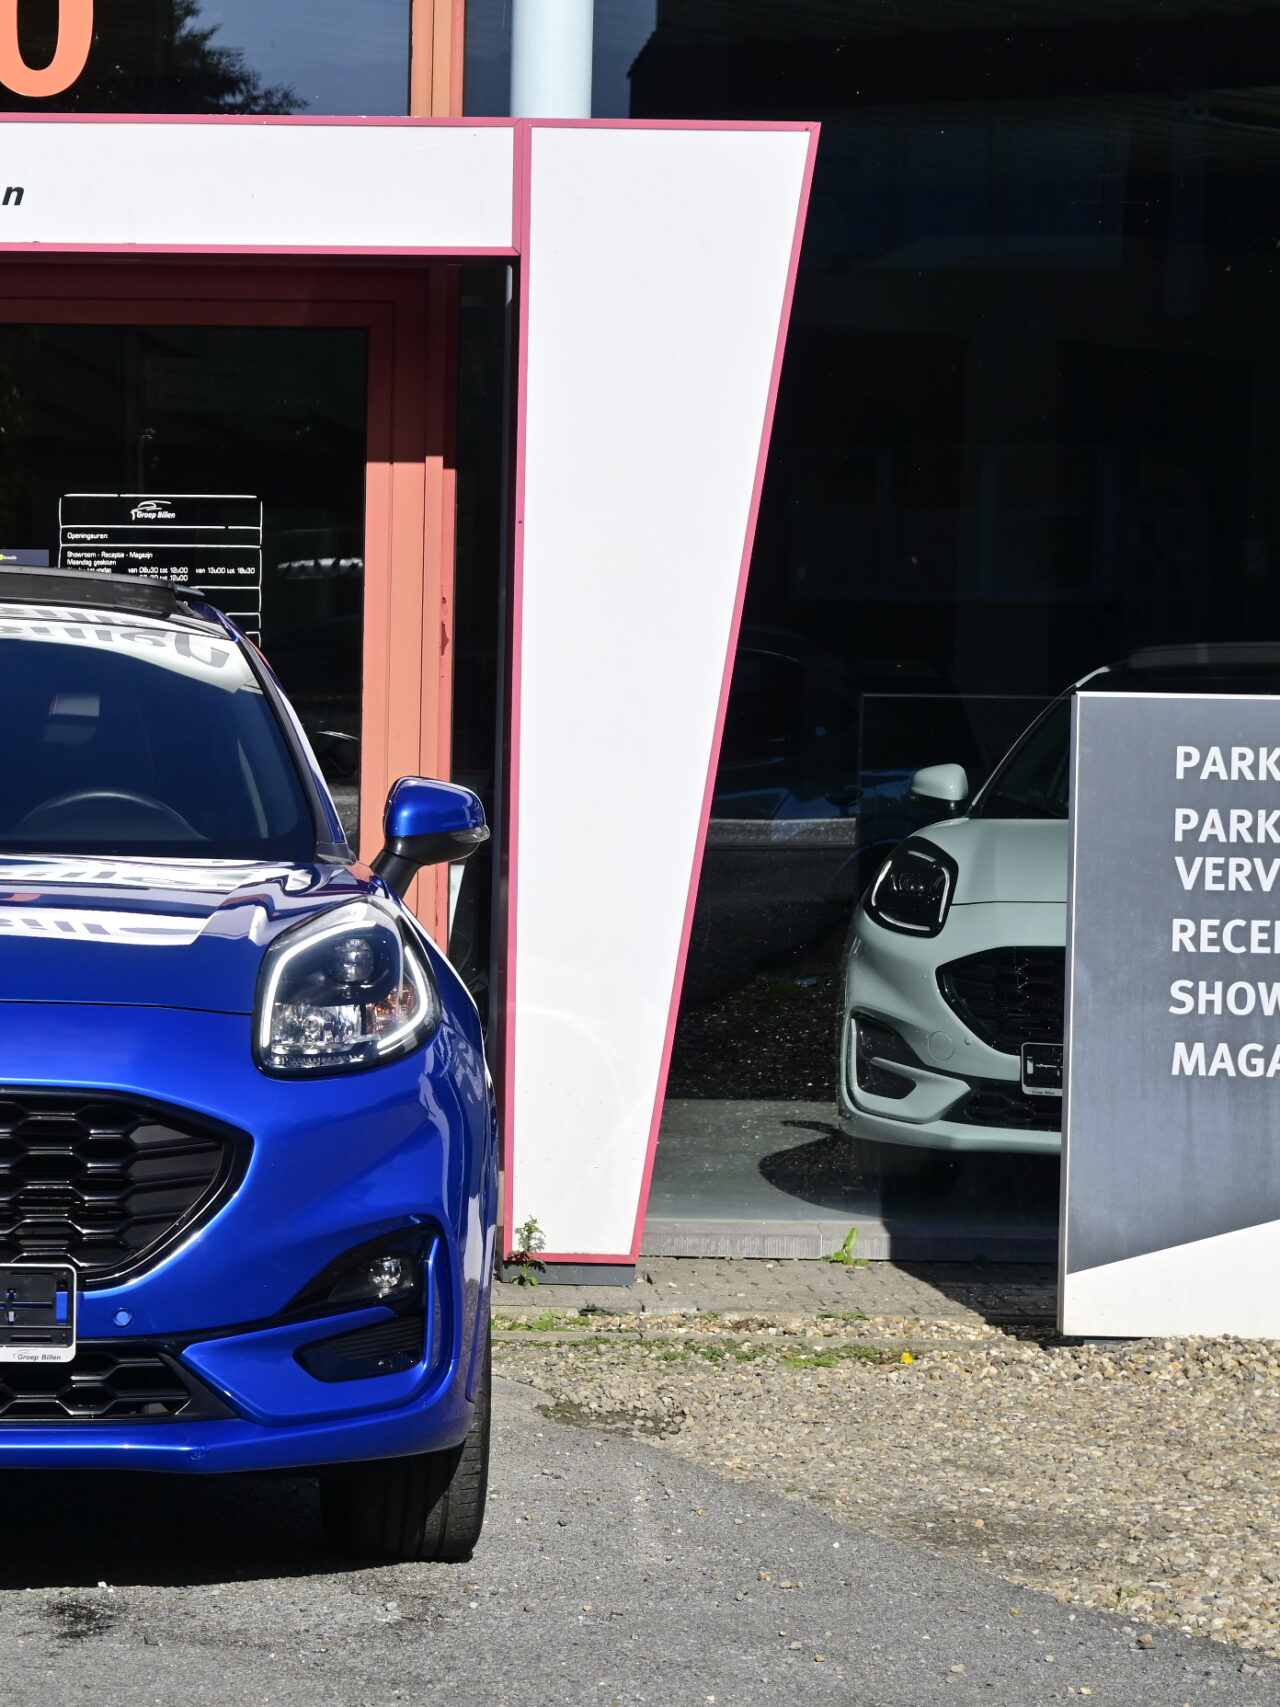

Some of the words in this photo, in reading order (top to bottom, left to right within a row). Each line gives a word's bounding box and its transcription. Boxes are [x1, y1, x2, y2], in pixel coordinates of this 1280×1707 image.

[1175, 745, 1280, 781] PARK
[1174, 808, 1280, 844] PARK
[1174, 856, 1280, 892] VERV
[1171, 918, 1280, 954] RECE
[1168, 979, 1280, 1016] SHOW
[17, 1354, 39, 1362] Groep
